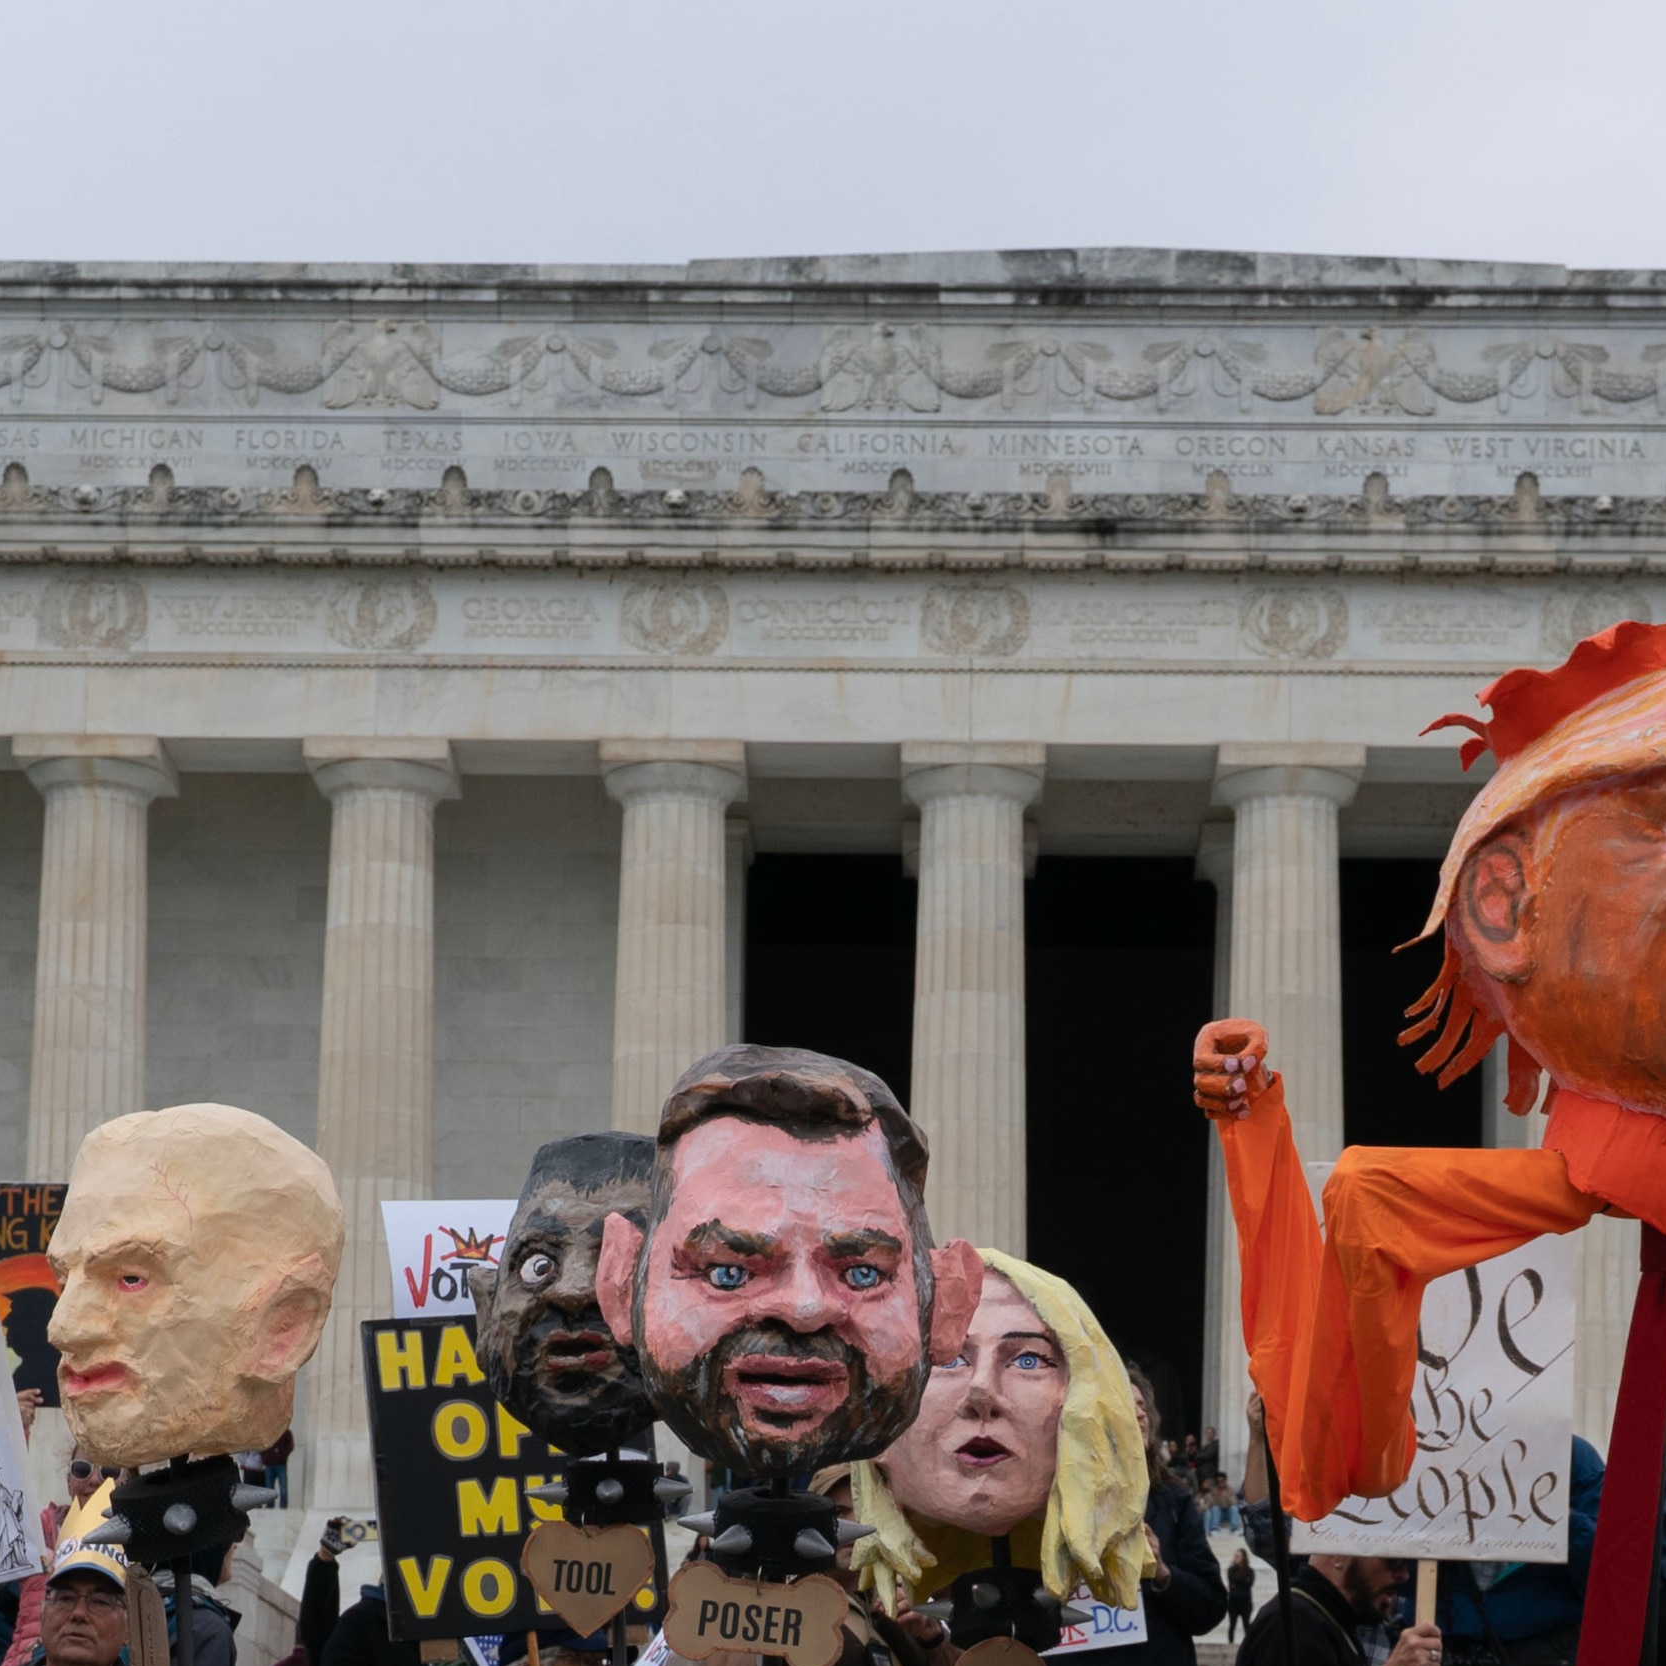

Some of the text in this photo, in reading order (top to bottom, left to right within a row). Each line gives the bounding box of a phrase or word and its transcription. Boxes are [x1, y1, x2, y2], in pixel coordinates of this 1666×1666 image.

[68, 428, 205, 451] MICHIGAN
[234, 429, 346, 451] FLORIDA
[382, 429, 464, 452] TEXAS
[503, 431, 578, 453] IOWA
[611, 432, 769, 454] WISCONSIN
[797, 433, 956, 456] CALIFORNIA
[987, 435, 1145, 457] MINNESOTA
[1174, 435, 1288, 457] OREGON
[1316, 437, 1418, 459] KANSAS
[1444, 437, 1514, 458] WEST
[1523, 437, 1646, 459] VIRGINIA
[461, 595, 602, 622] GEORGIA
[405, 1234, 487, 1310] VOT
[434, 1402, 569, 1459] OF
[552, 1558, 617, 1596] TOOL
[697, 1599, 804, 1647] POSER
[1091, 1605, 1139, 1635] D.C.
